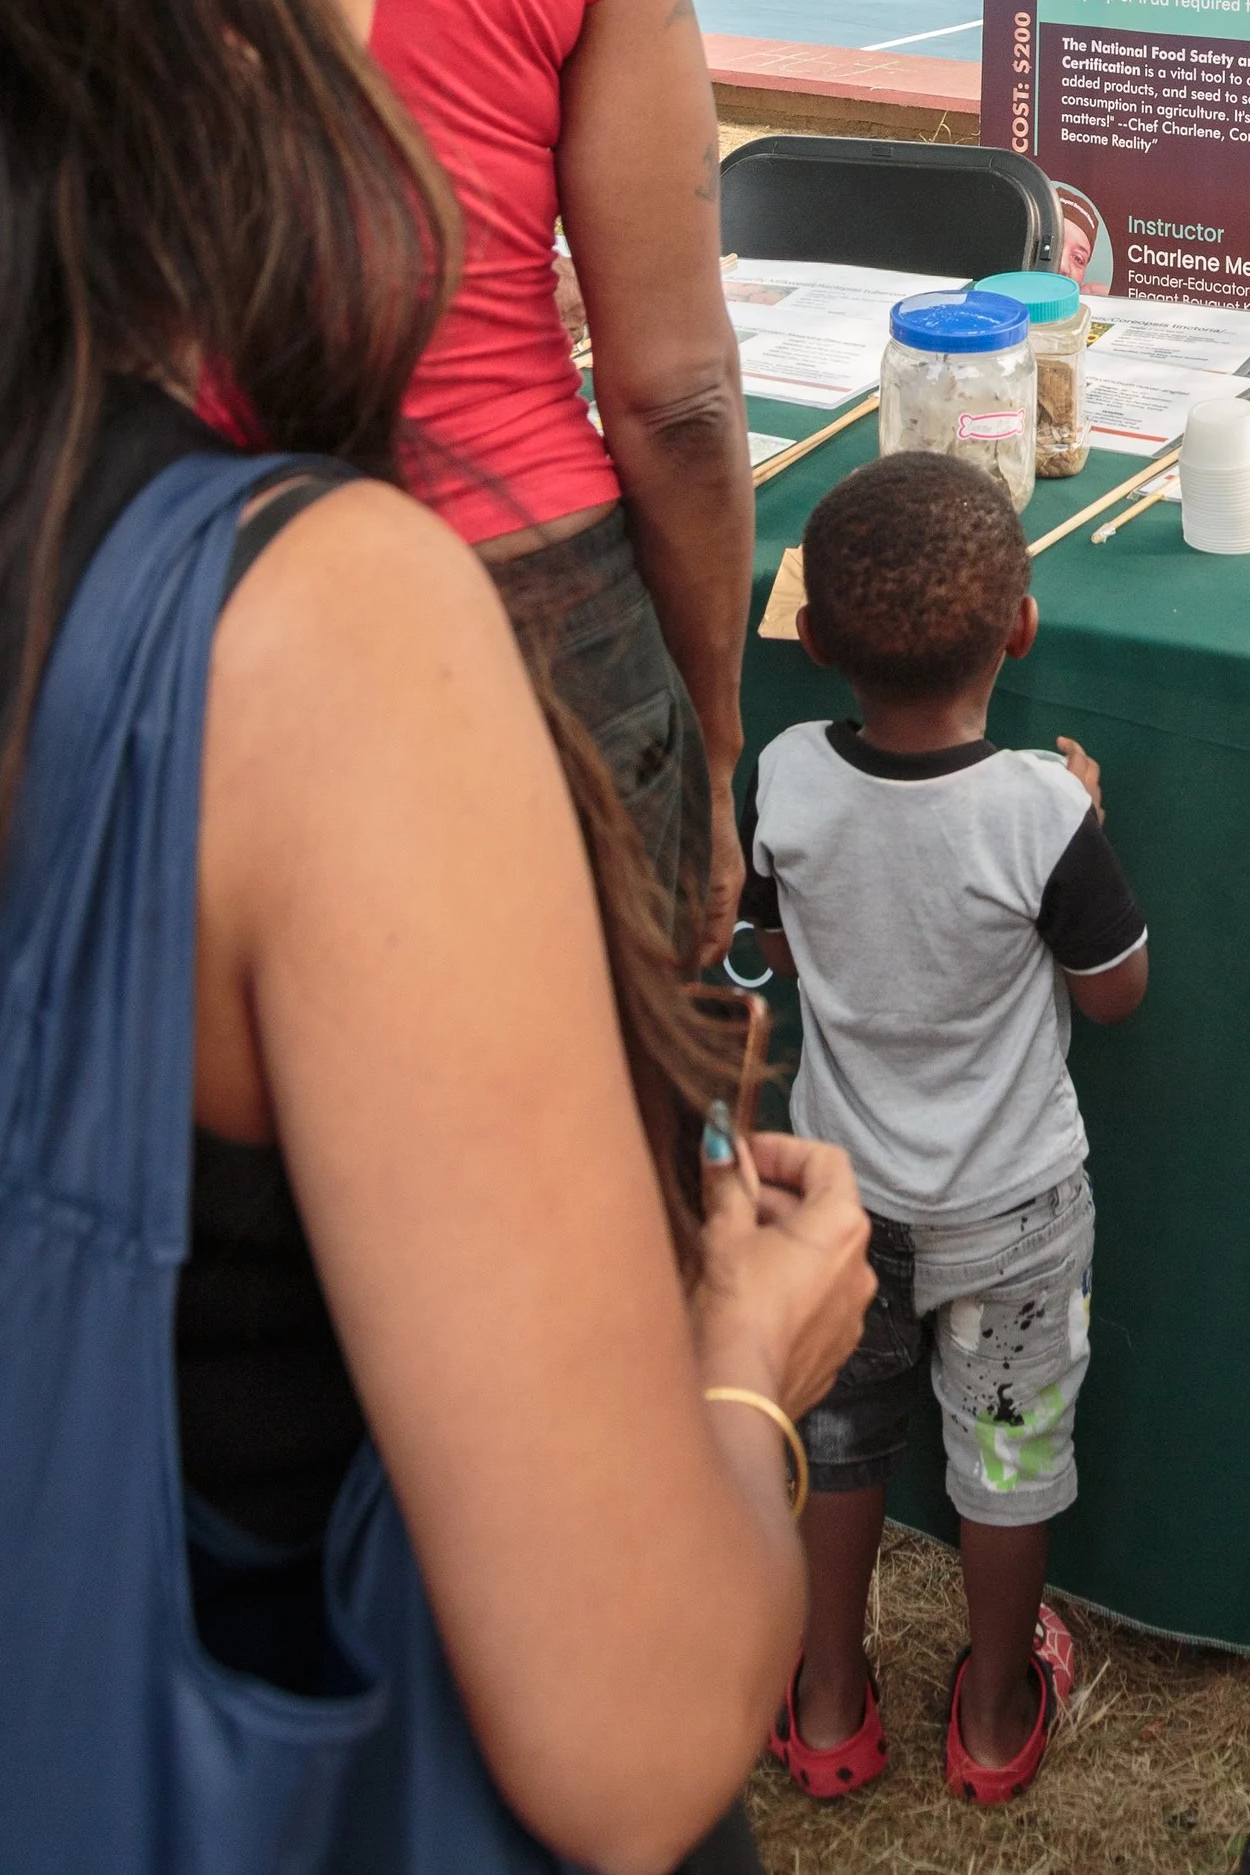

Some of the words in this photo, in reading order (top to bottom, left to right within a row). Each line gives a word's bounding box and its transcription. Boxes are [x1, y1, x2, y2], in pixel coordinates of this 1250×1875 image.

[1012, 11, 1032, 75] $200
[1062, 37, 1087, 51] The
[1092, 40, 1147, 58] National
[1152, 47, 1185, 61] Food
[1190, 50, 1234, 68] Safety
[1062, 56, 1140, 75] Certification
[1145, 64, 1154, 77] is
[1158, 69, 1166, 78] a
[1170, 67, 1196, 81] vital
[1201, 71, 1225, 83] tool
[1230, 73, 1242, 85] to
[1012, 82, 1030, 154] COST:
[1118, 118, 1158, 132] --Chef
[1162, 121, 1224, 141] Charlene,
[1062, 128, 1108, 145] Become
[1129, 216, 1224, 243] Instructor
[1128, 245, 1220, 272] Charlene
